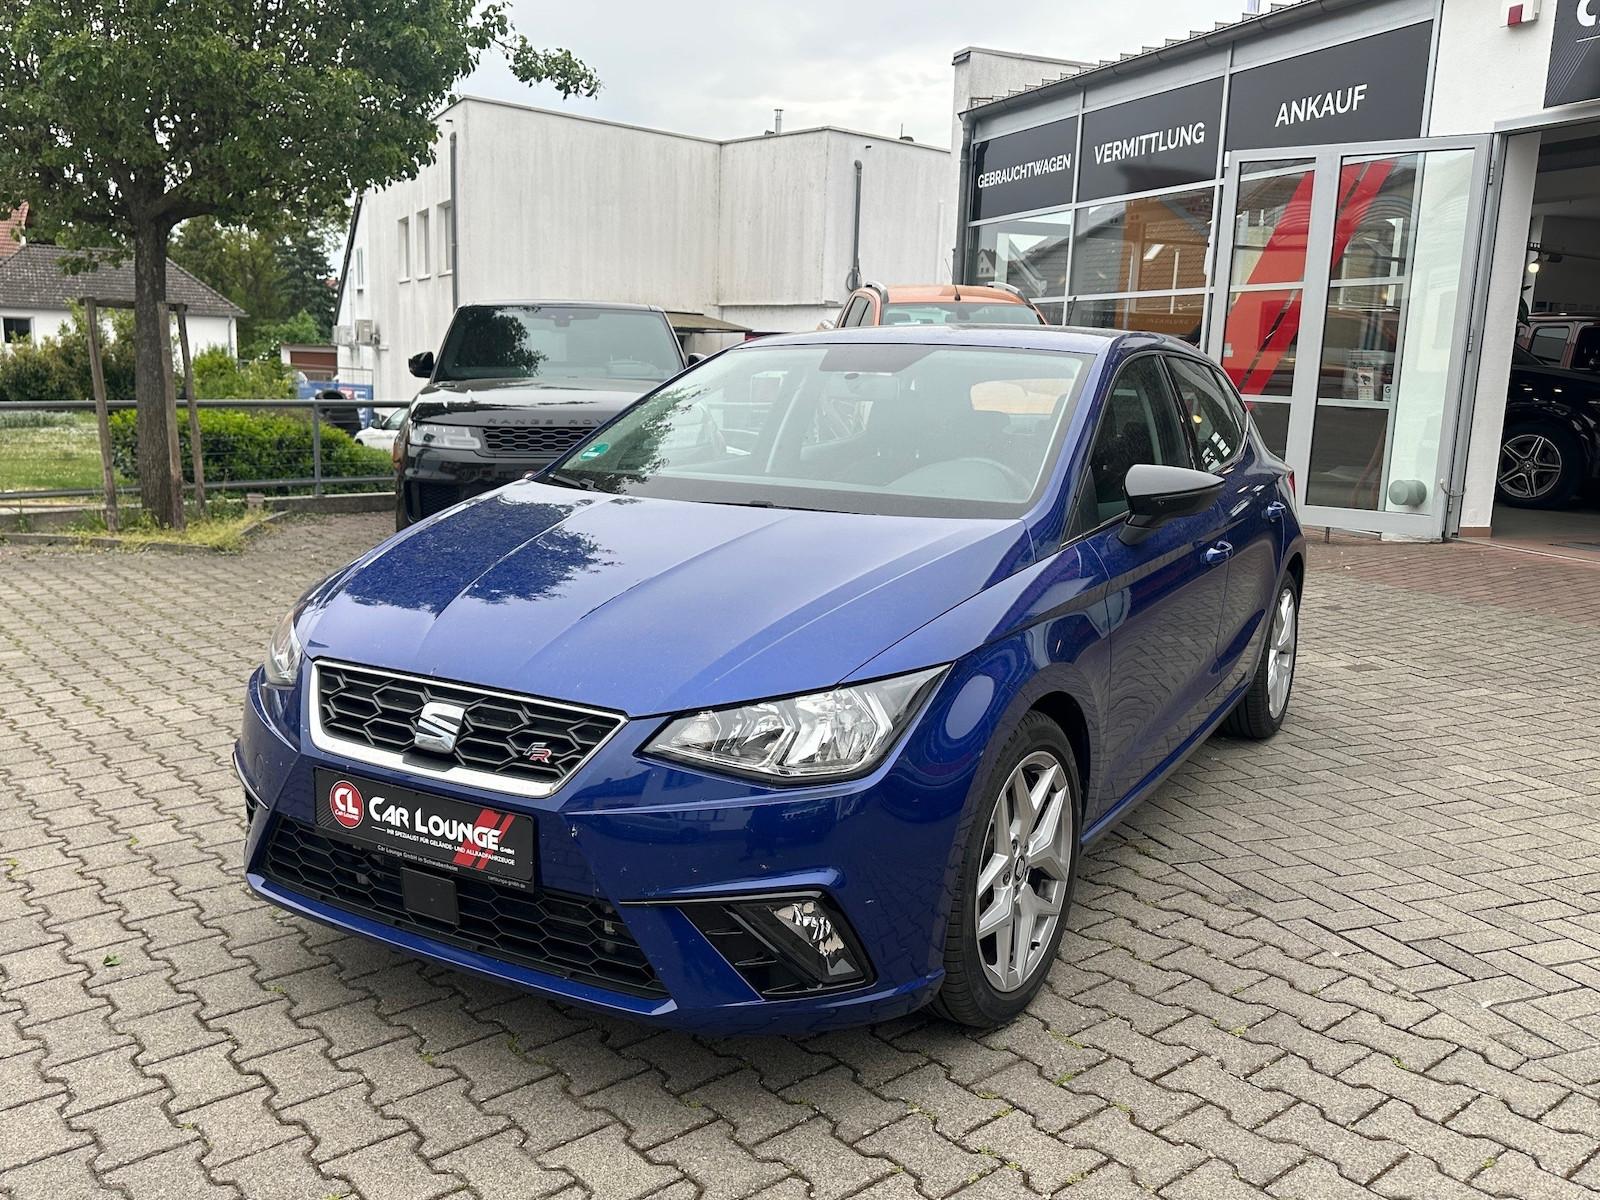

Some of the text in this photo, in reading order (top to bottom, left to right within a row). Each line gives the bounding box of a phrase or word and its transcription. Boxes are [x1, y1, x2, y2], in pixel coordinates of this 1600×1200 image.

[1275, 84, 1368, 127] ANKAUF
[1094, 123, 1205, 165] VERMITTLUNG
[978, 153, 1072, 188] GEBRAUCHTWAGEN
[523, 742, 552, 764] FR
[335, 787, 359, 815] CL
[369, 796, 502, 851] CAR LOUNGE
[386, 847, 402, 857] Lounge
[403, 852, 418, 860] GmbH
[395, 830, 419, 842] SPEZIALIST
[420, 836, 430, 844] FÜR
[430, 840, 454, 850] GELÄNDE-
[454, 845, 466, 853] UND
[465, 849, 516, 866] ALLRADFAHRZEUGE
